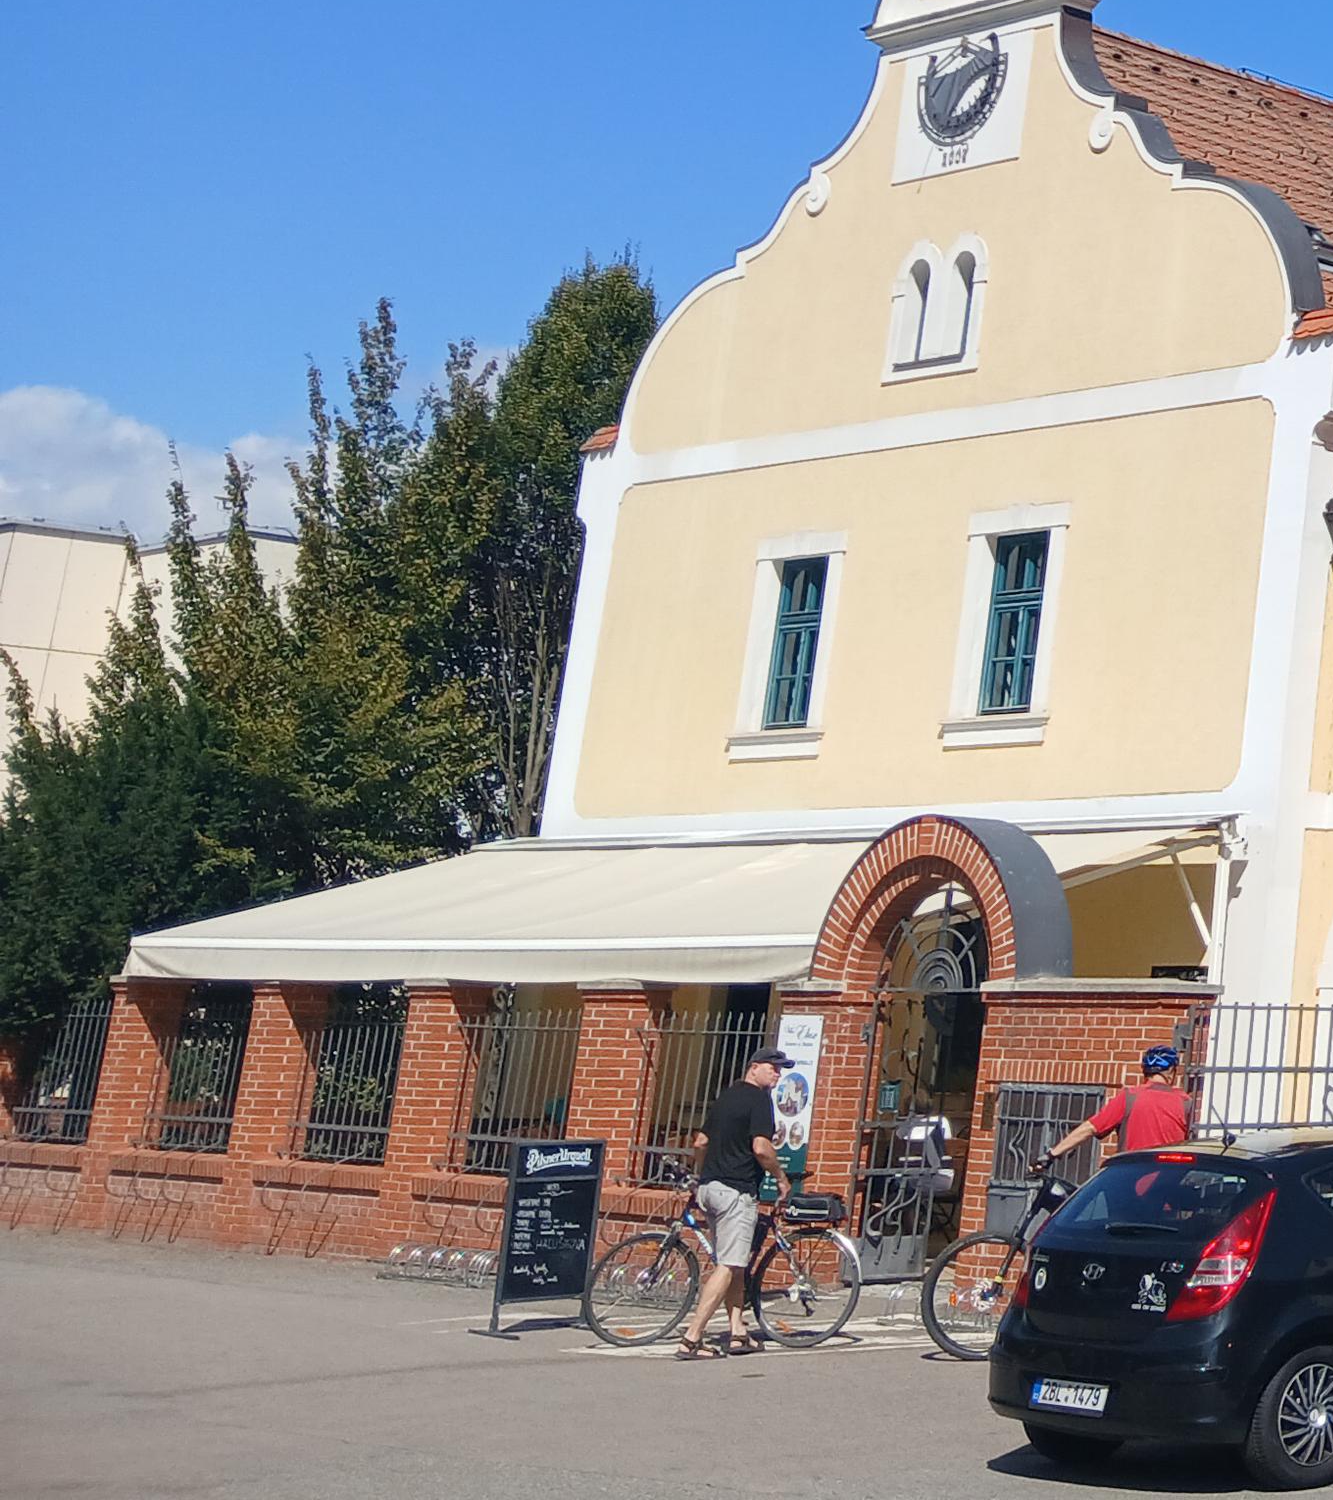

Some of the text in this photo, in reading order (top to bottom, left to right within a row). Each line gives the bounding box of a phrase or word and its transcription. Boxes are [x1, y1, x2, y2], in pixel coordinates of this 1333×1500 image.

[526, 1148, 560, 1174] Pilsner
[1042, 1381, 1102, 1406] 2BL 1479
